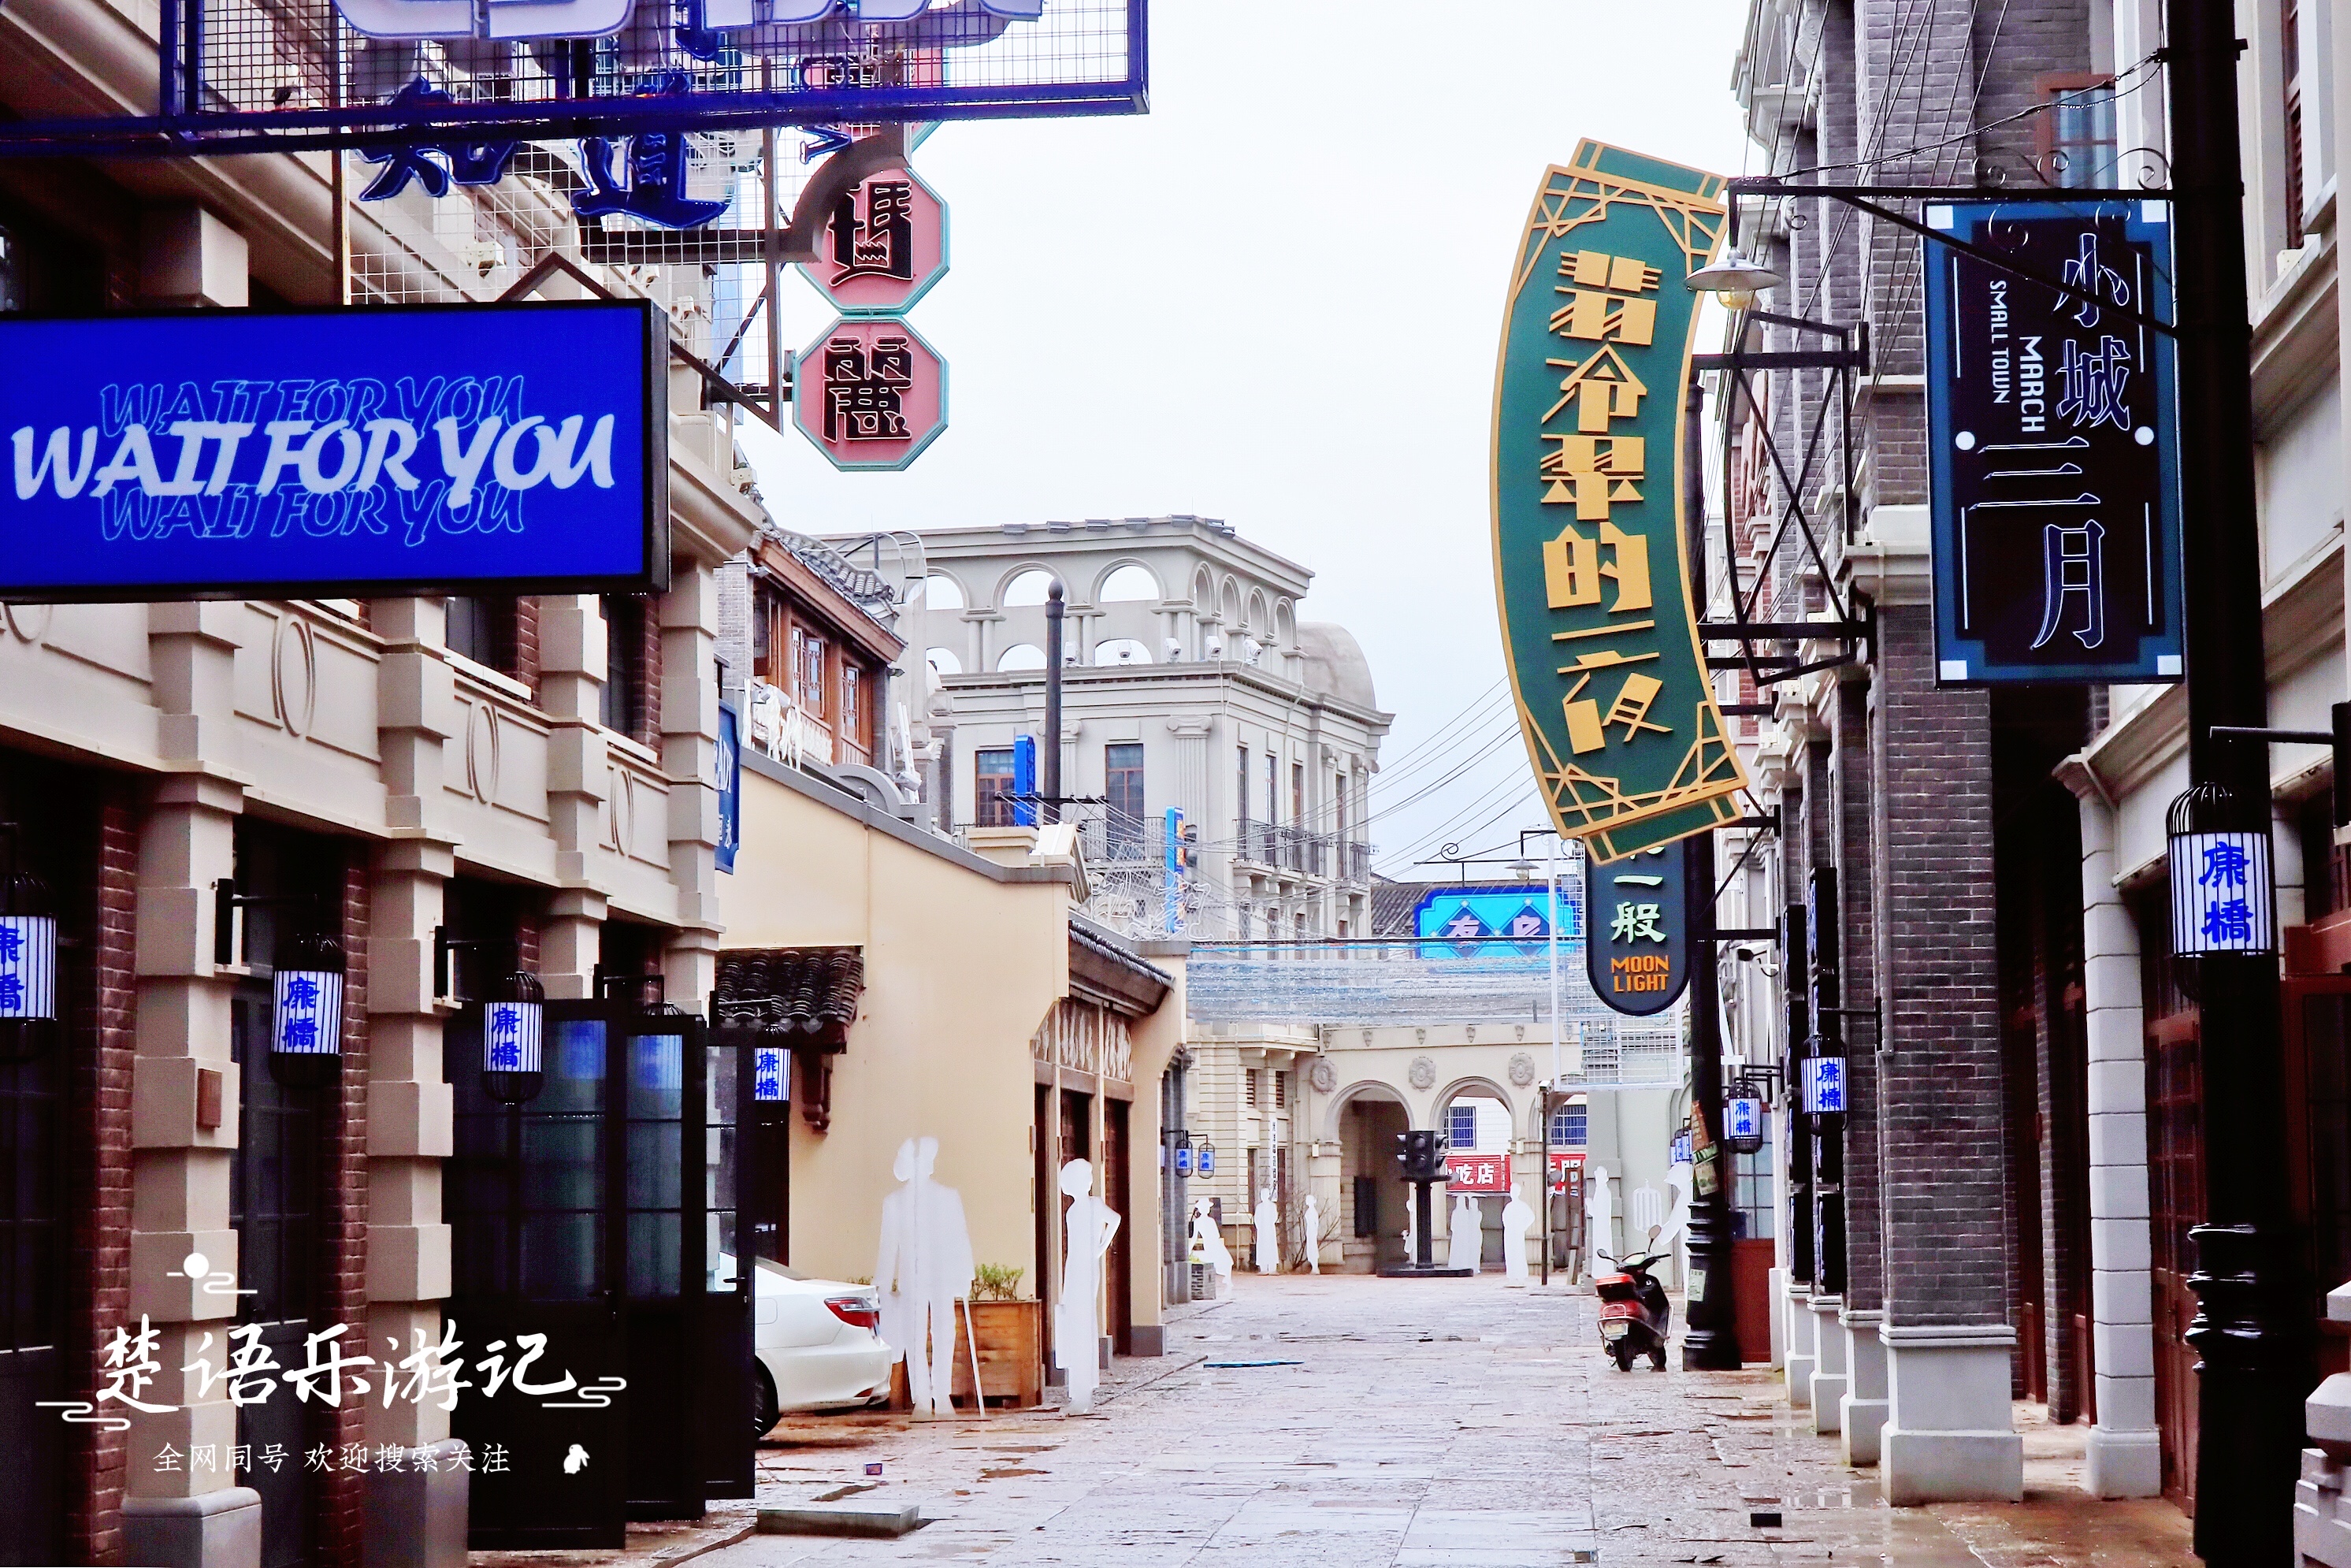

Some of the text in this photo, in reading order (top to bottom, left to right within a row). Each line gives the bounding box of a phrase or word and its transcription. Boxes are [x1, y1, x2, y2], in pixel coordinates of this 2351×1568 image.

[1989, 279, 2011, 404] SMALL TOWN
[2019, 336, 2045, 433] MARCH
[11, 413, 616, 508] WAIT FOR YOU
[1969, 233, 2131, 648] 小城三月
[1610, 846, 1667, 944] 一般
[1610, 954, 1670, 975] MOON
[1613, 974, 1669, 994] LIGHT
